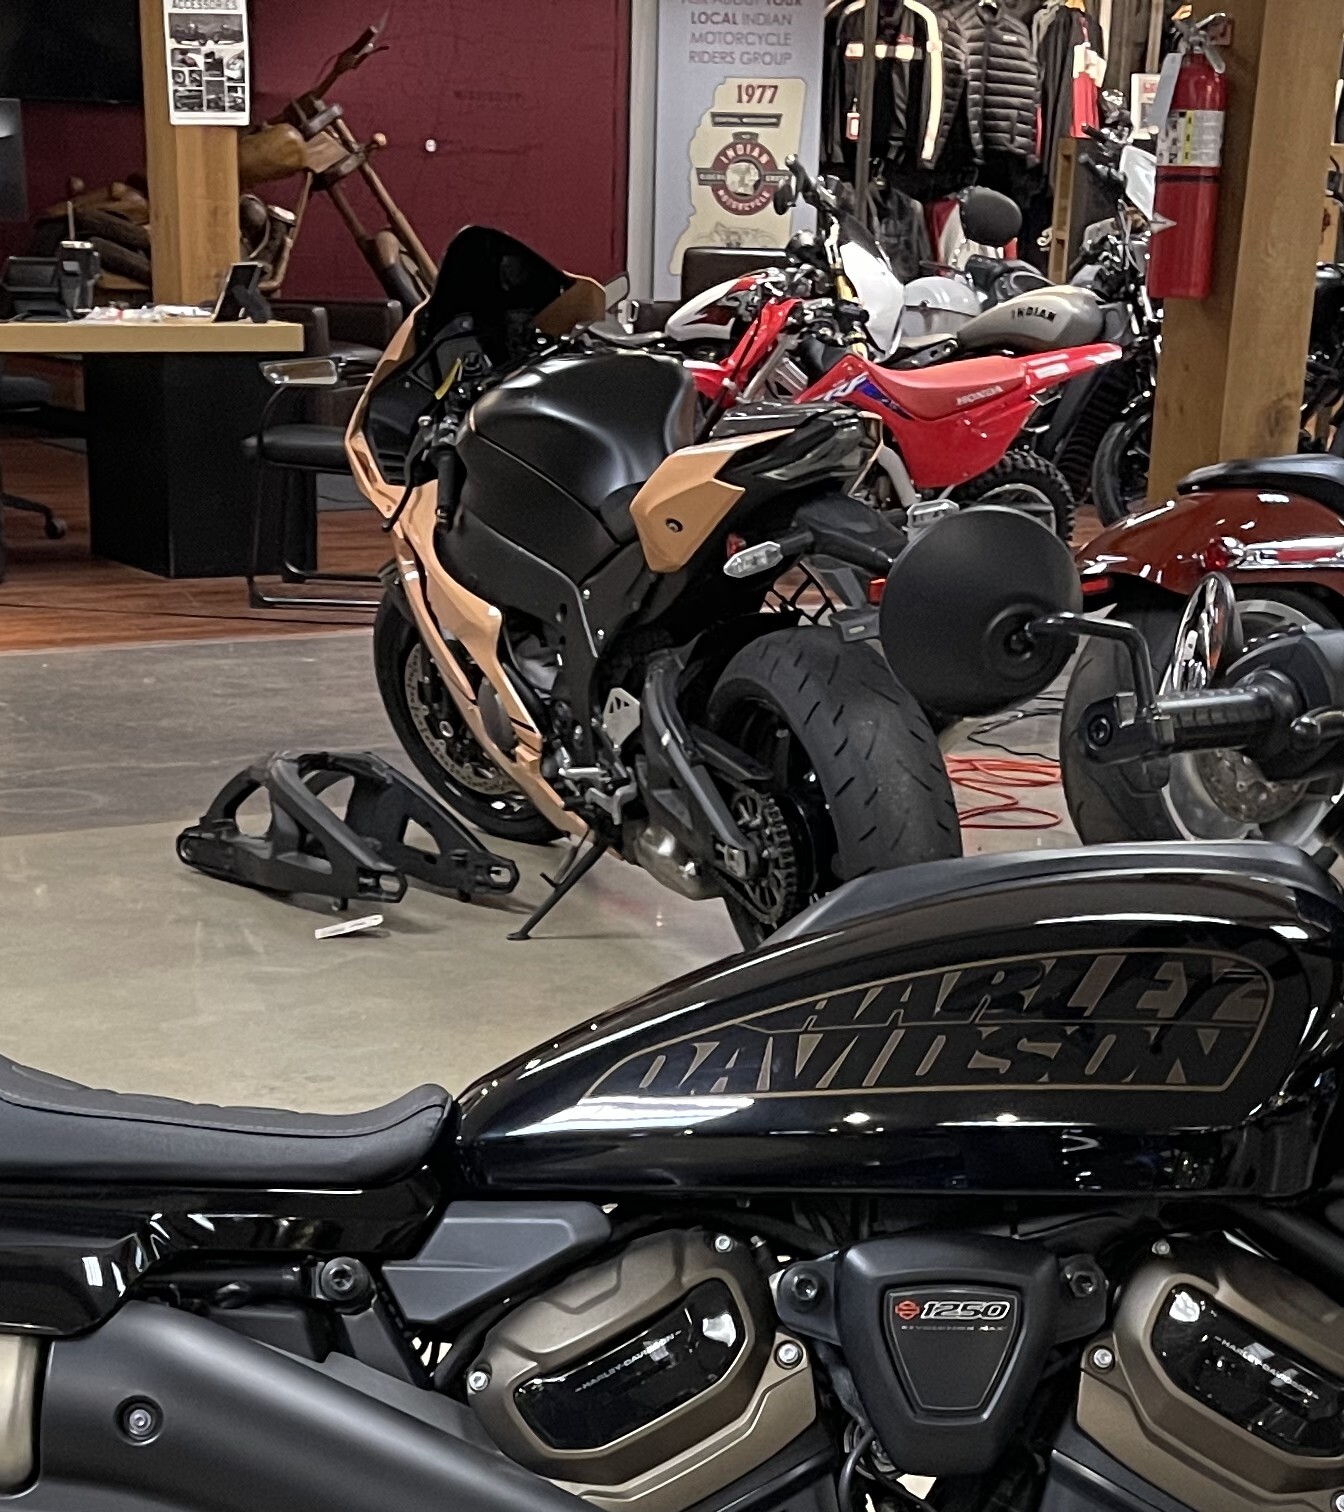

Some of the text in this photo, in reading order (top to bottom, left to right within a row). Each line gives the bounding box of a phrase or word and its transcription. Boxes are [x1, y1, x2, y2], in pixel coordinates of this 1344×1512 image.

[690, 11, 793, 26] LOCAL INDIAN
[690, 31, 793, 46] MOTORCYCLE
[688, 50, 793, 66] RIDERS GROUP
[736, 84, 779, 104] 1977
[720, 143, 771, 165] INDIAN
[1011, 306, 1057, 322] INDIAN
[957, 385, 1004, 405] HONDA
[771, 952, 1264, 1028] HARLEY
[596, 1028, 1254, 1093] DAVIDSON
[920, 1301, 1011, 1320] 1250
